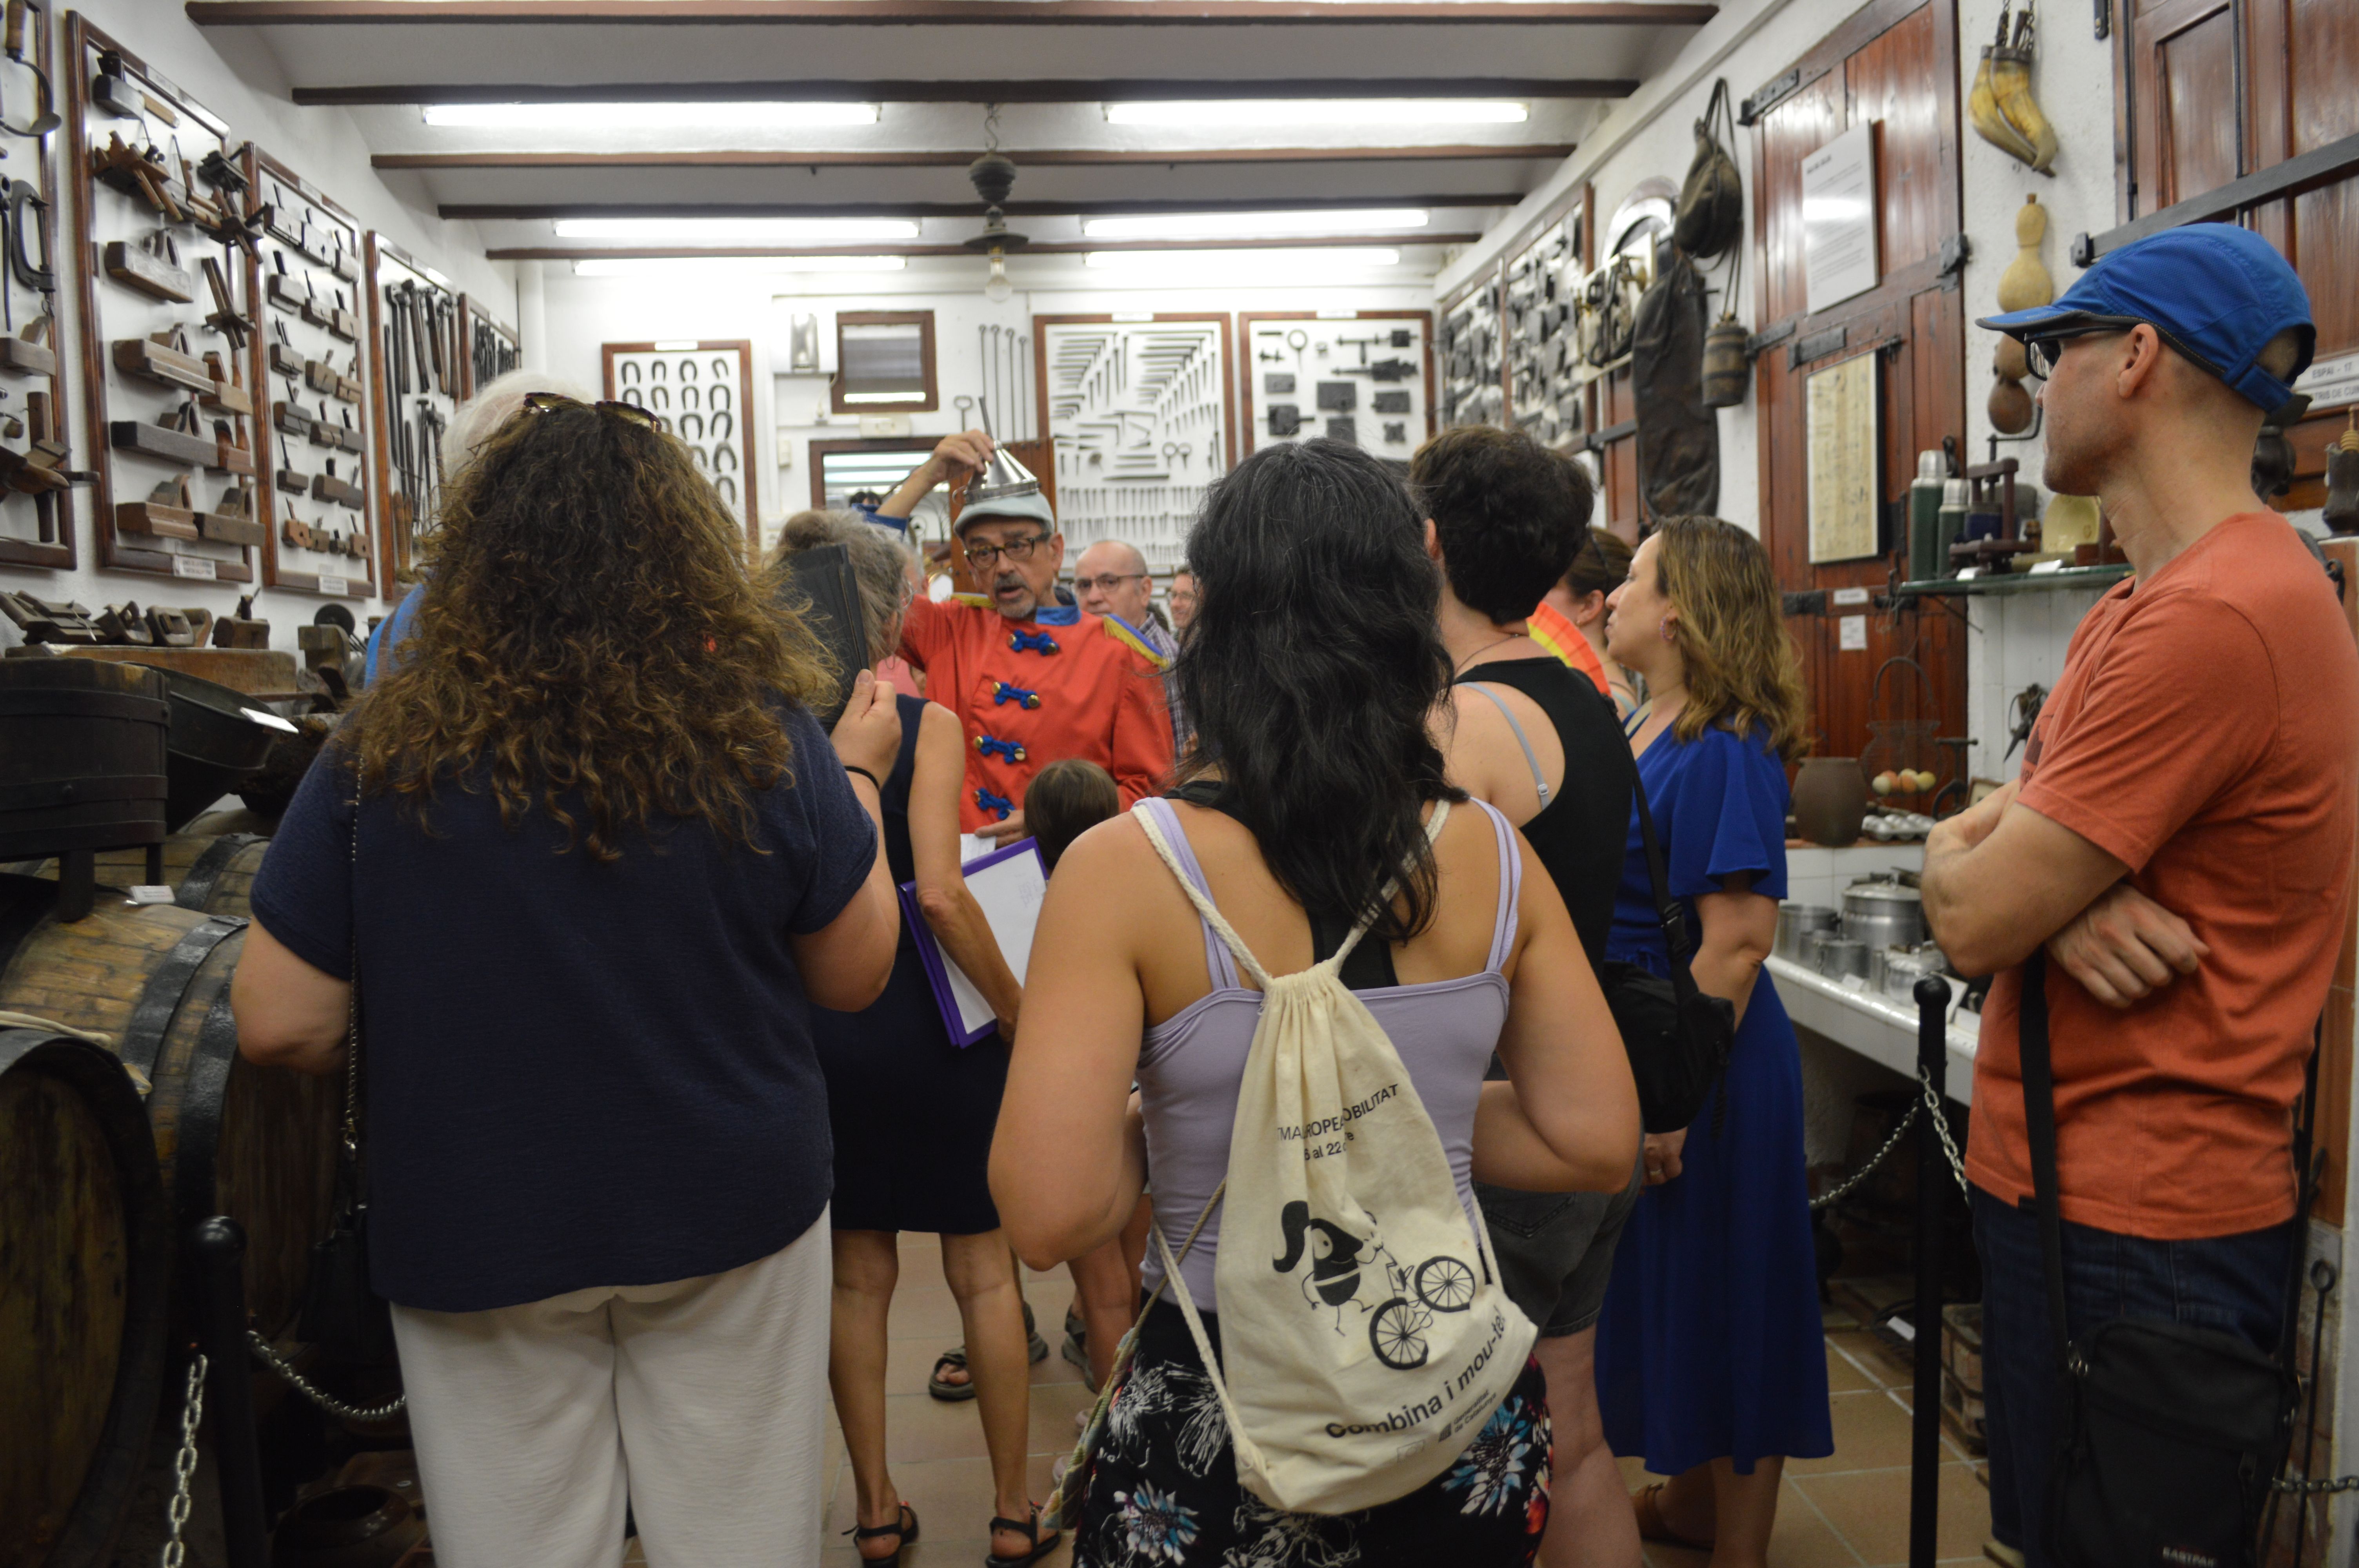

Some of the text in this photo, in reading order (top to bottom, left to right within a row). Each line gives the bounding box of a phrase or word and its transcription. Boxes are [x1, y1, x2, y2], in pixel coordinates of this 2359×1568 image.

[2312, 366, 2334, 379] ESPAI
[2344, 362, 2353, 372] 17
[2332, 388, 2342, 399] DE
[1312, 1145, 1323, 1159] al
[1326, 1141, 1341, 1155] 22
[1325, 1395, 1443, 1438] Combina
[1444, 1380, 1454, 1401] i
[1454, 1389, 1489, 1425] Generalitat
